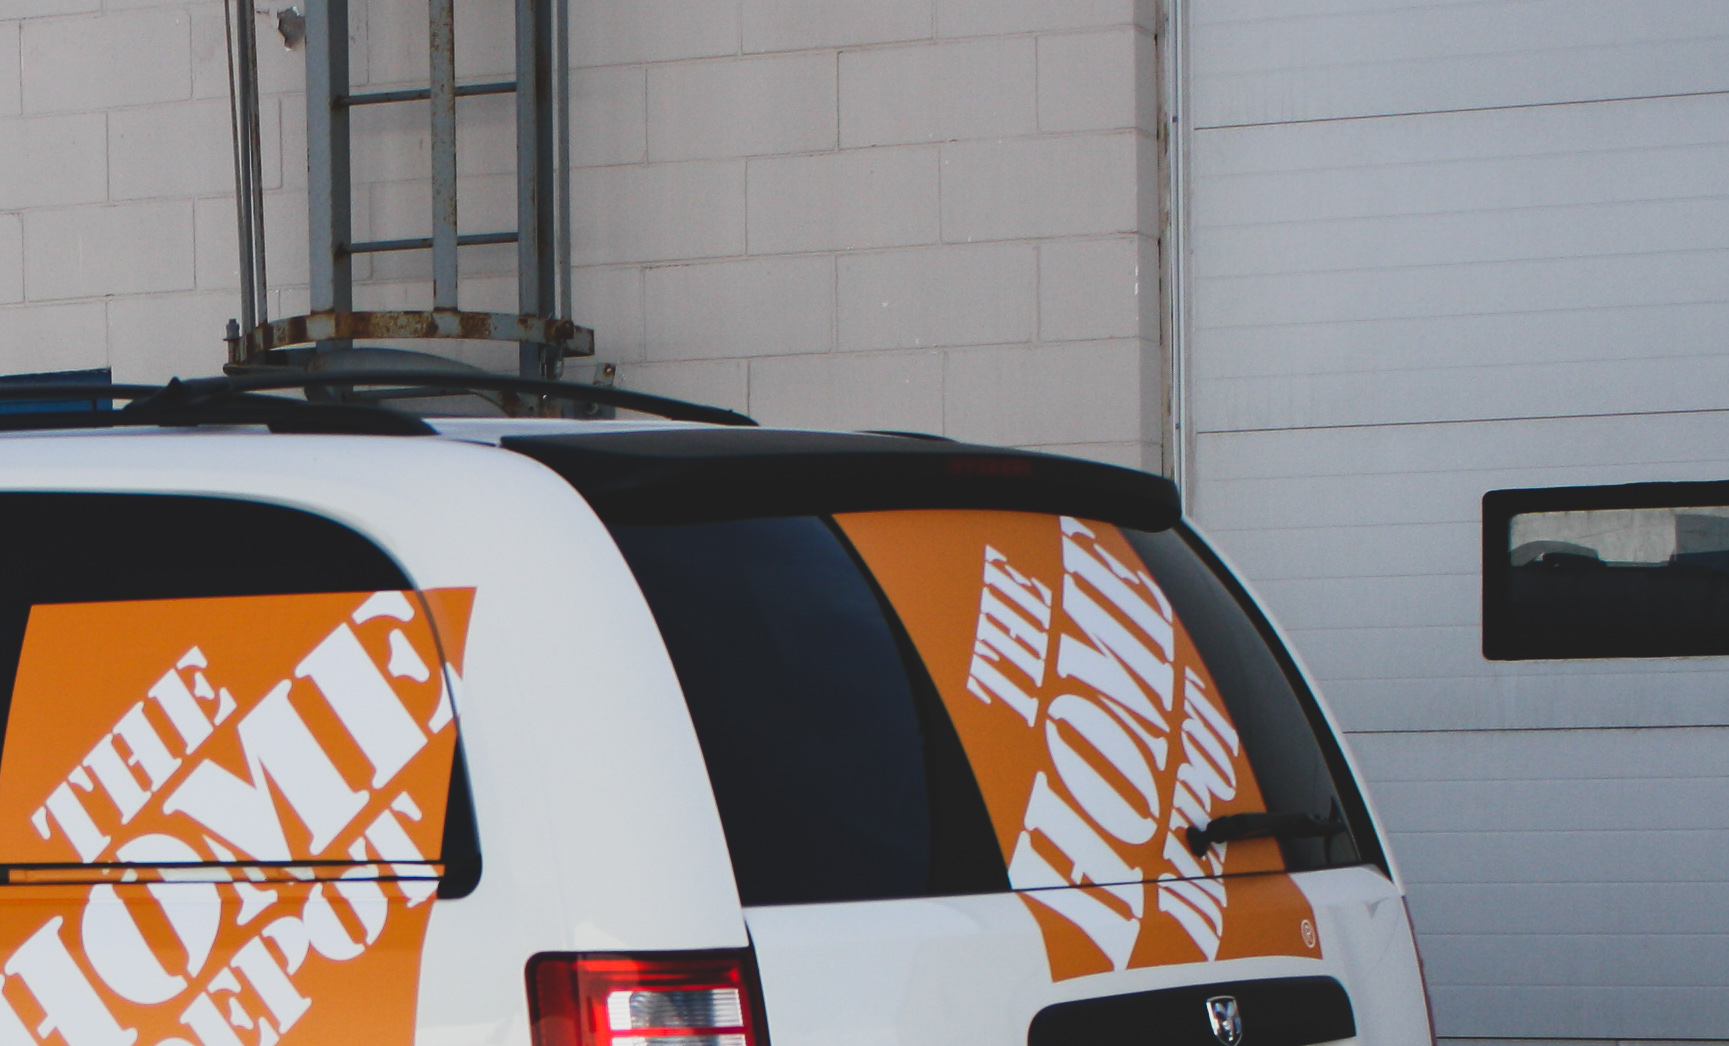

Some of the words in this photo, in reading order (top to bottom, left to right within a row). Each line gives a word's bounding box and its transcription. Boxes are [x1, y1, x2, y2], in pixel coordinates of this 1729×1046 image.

[30, 645, 237, 868] THE
[967, 544, 1053, 727] THE
[1007, 515, 1175, 971] HOME
[1157, 666, 1239, 962] DEPOT
